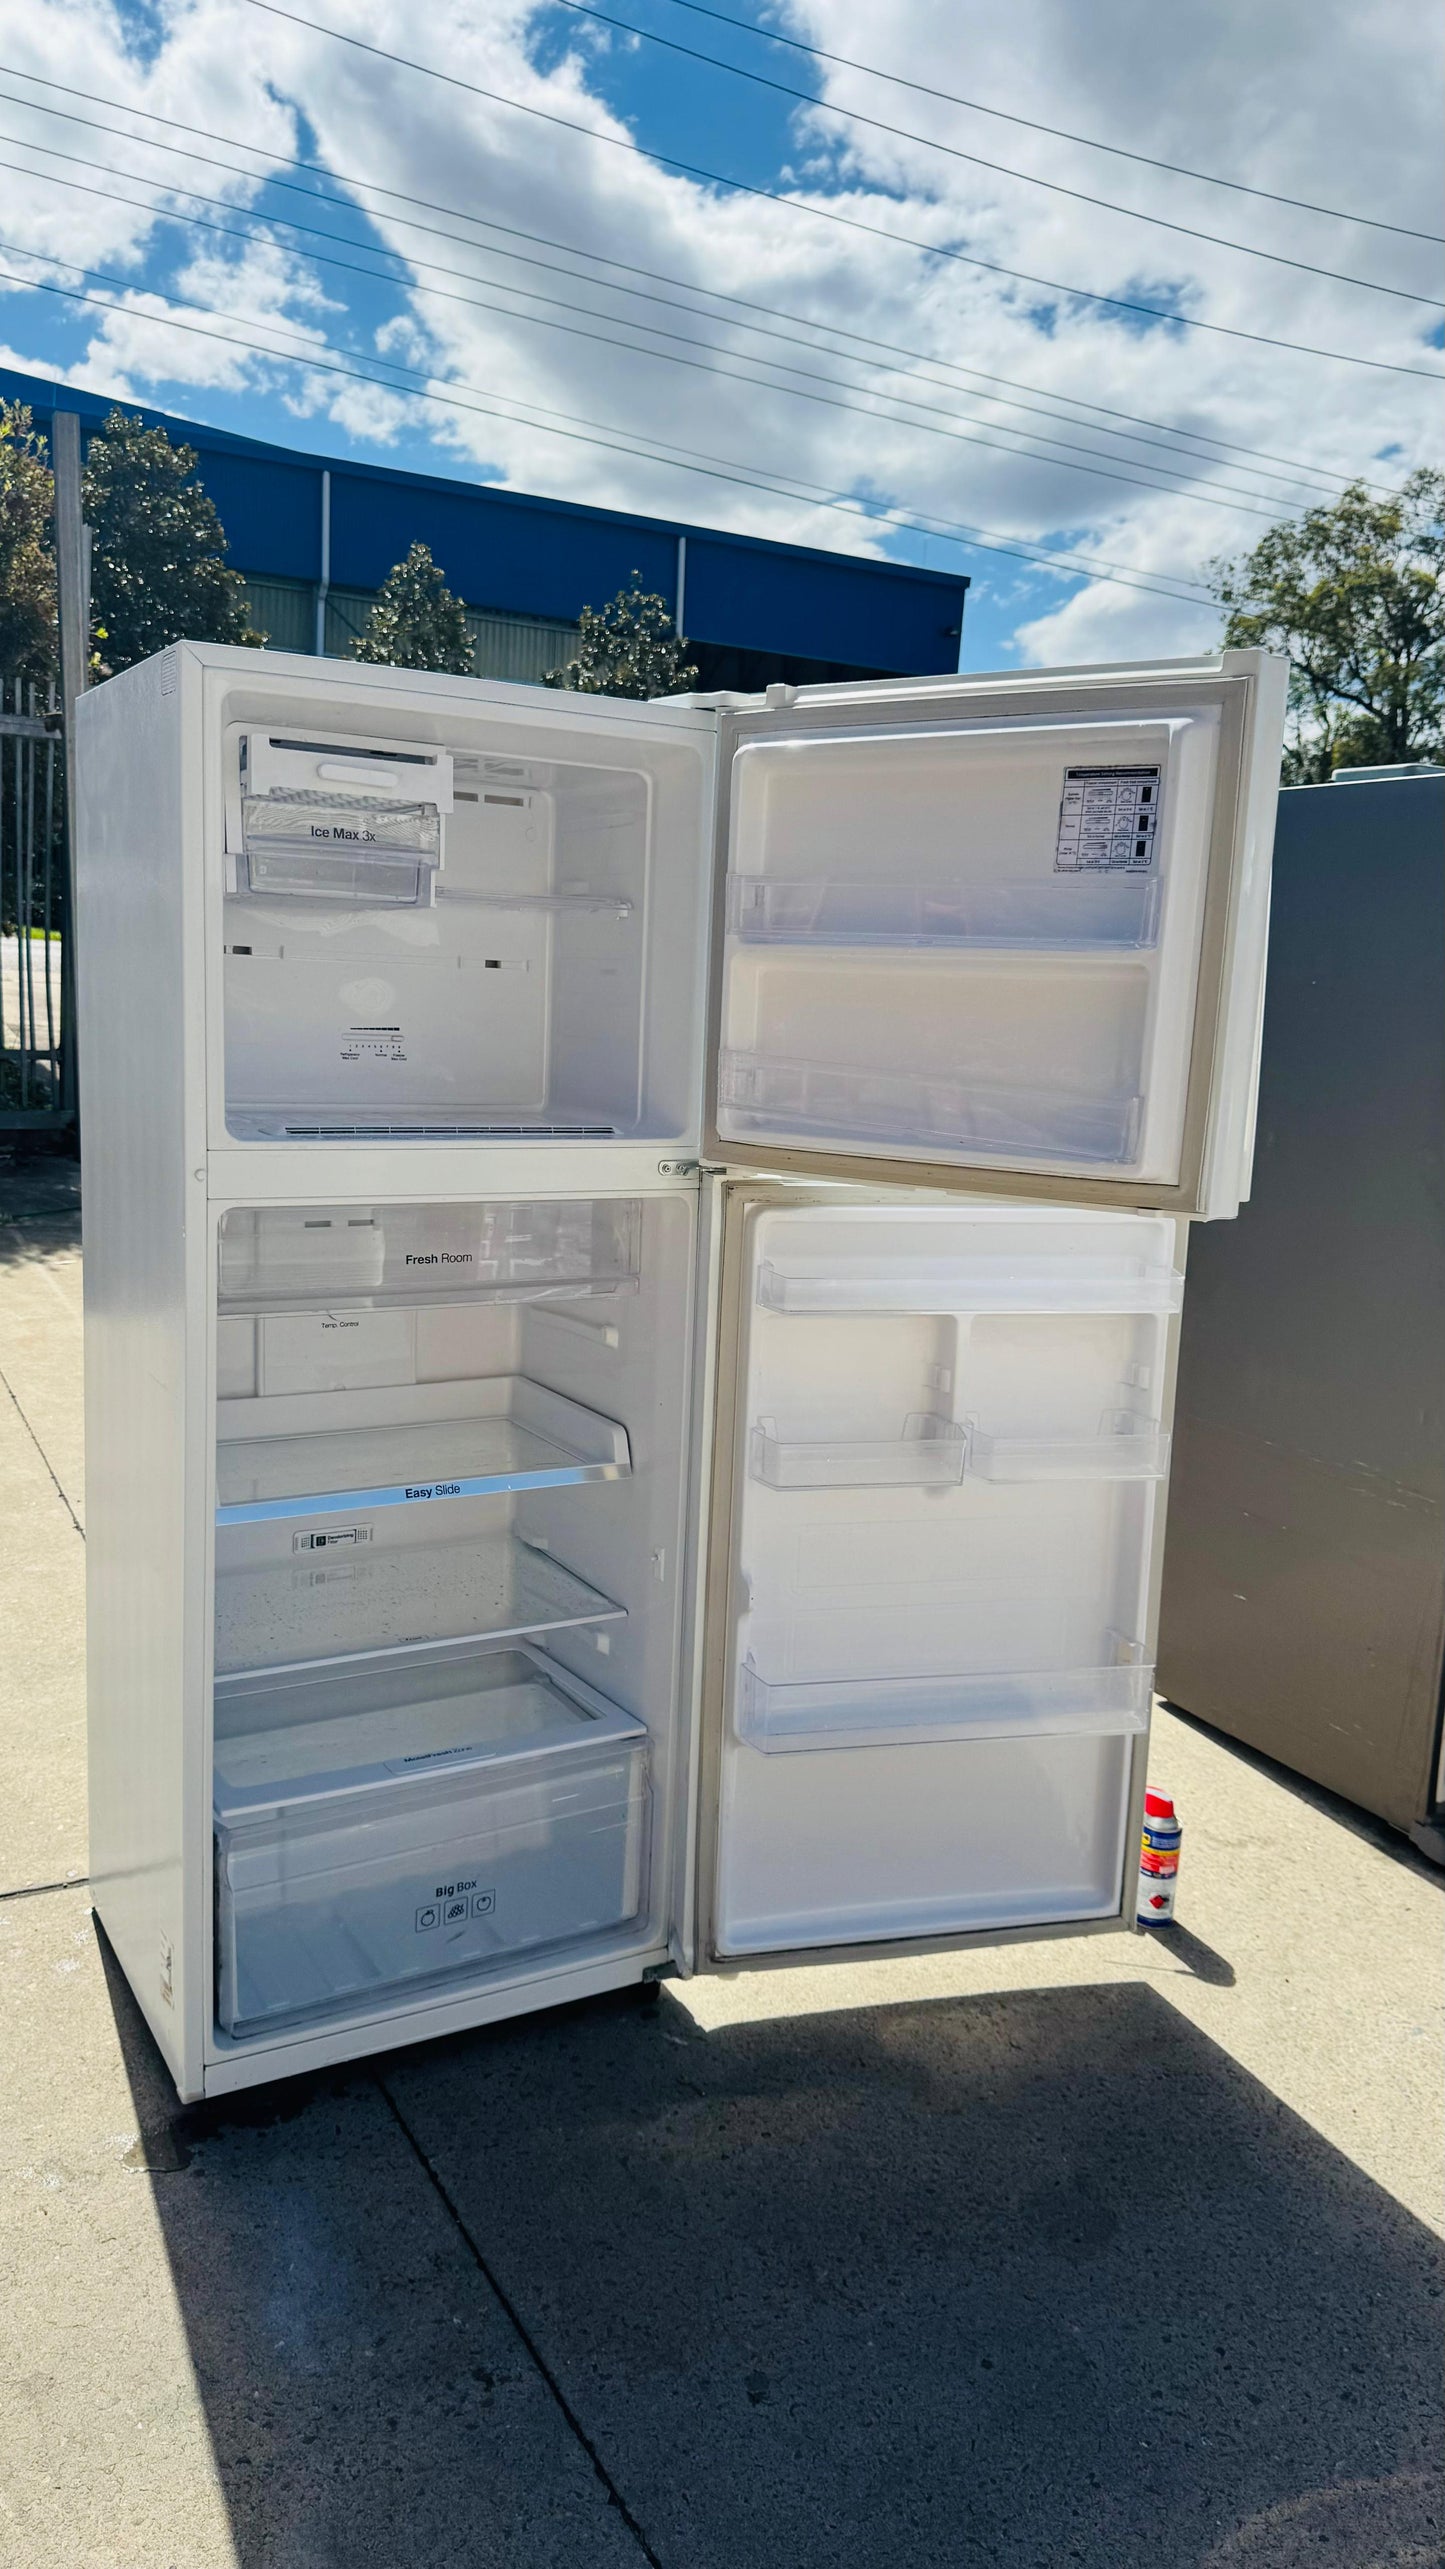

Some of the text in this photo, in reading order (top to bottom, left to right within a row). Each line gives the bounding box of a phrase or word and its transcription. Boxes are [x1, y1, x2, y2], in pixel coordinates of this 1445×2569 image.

[311, 826, 377, 842] Ice Max 3x
[406, 1252, 473, 1265] Fresh Room
[405, 1484, 460, 1499] Easy Slide
[436, 1880, 477, 1898] Big Box
